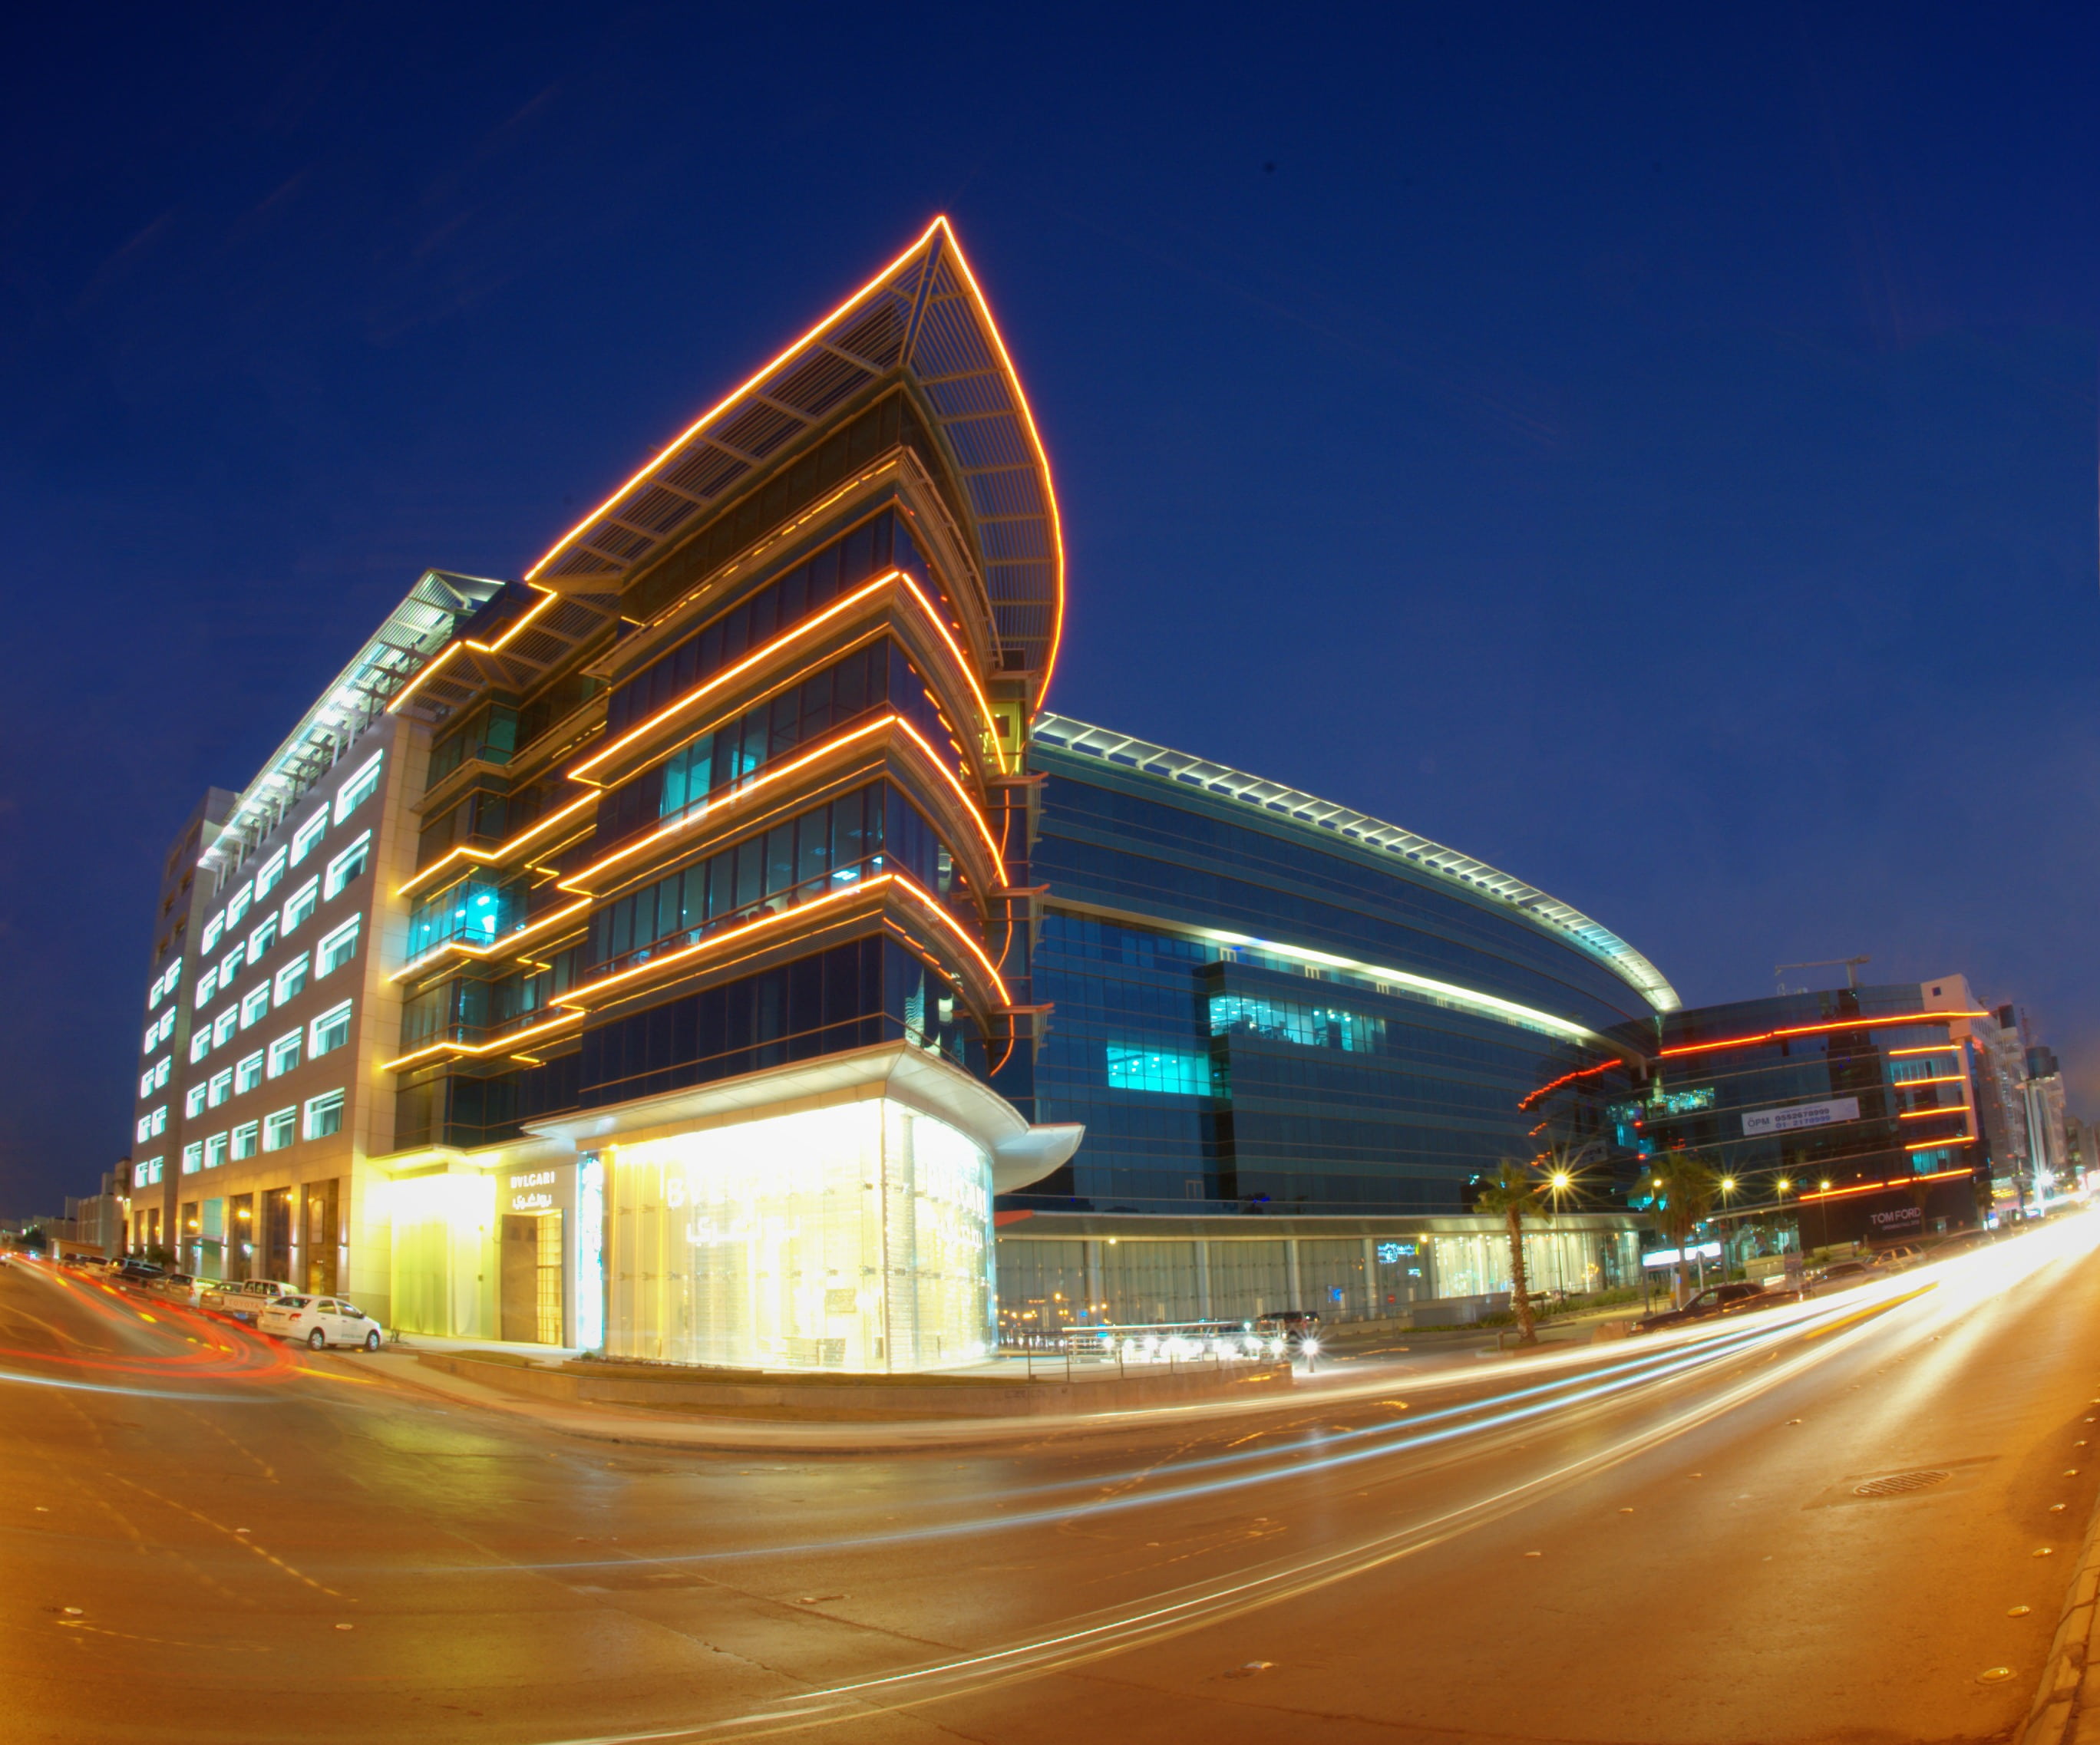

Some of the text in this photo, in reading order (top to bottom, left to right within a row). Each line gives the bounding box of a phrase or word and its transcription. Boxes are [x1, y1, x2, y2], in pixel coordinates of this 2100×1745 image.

[510, 1171, 555, 1188] BVLGARI
[1870, 1211, 1894, 1225] TOM
[1895, 1207, 1922, 1222] FORD
[229, 1300, 259, 1308] TOYOTA
